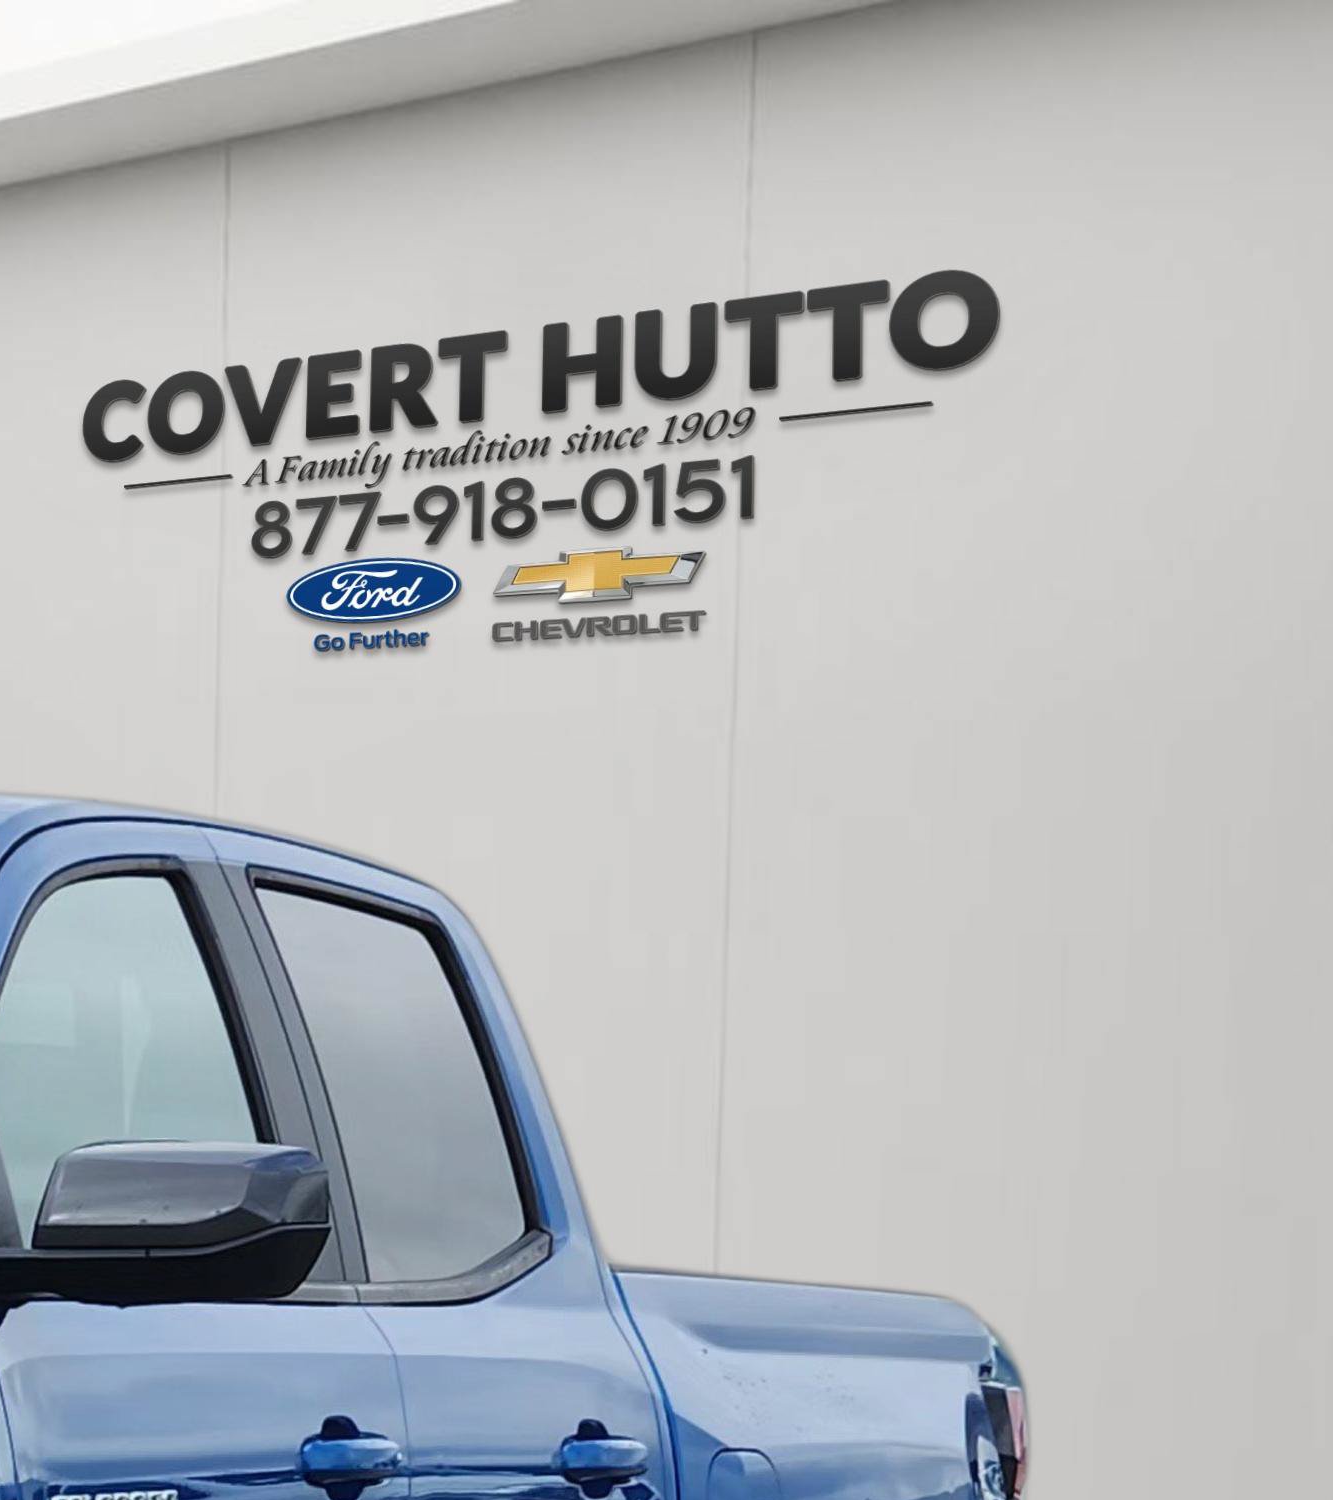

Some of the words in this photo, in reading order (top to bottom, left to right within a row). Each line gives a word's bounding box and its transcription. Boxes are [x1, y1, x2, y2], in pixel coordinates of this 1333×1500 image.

[82, 330, 509, 464] COVERT
[541, 269, 1002, 415] HUTTO
[242, 457, 270, 488] A
[275, 439, 393, 489] Family
[402, 428, 552, 472] tradition
[561, 424, 649, 456] since
[657, 405, 757, 446] 1909
[250, 453, 756, 560] 877-918-0151
[321, 571, 421, 614] Ford
[312, 630, 346, 654] Go
[348, 627, 431, 653] Further
[490, 609, 708, 643] CHEVROLET
